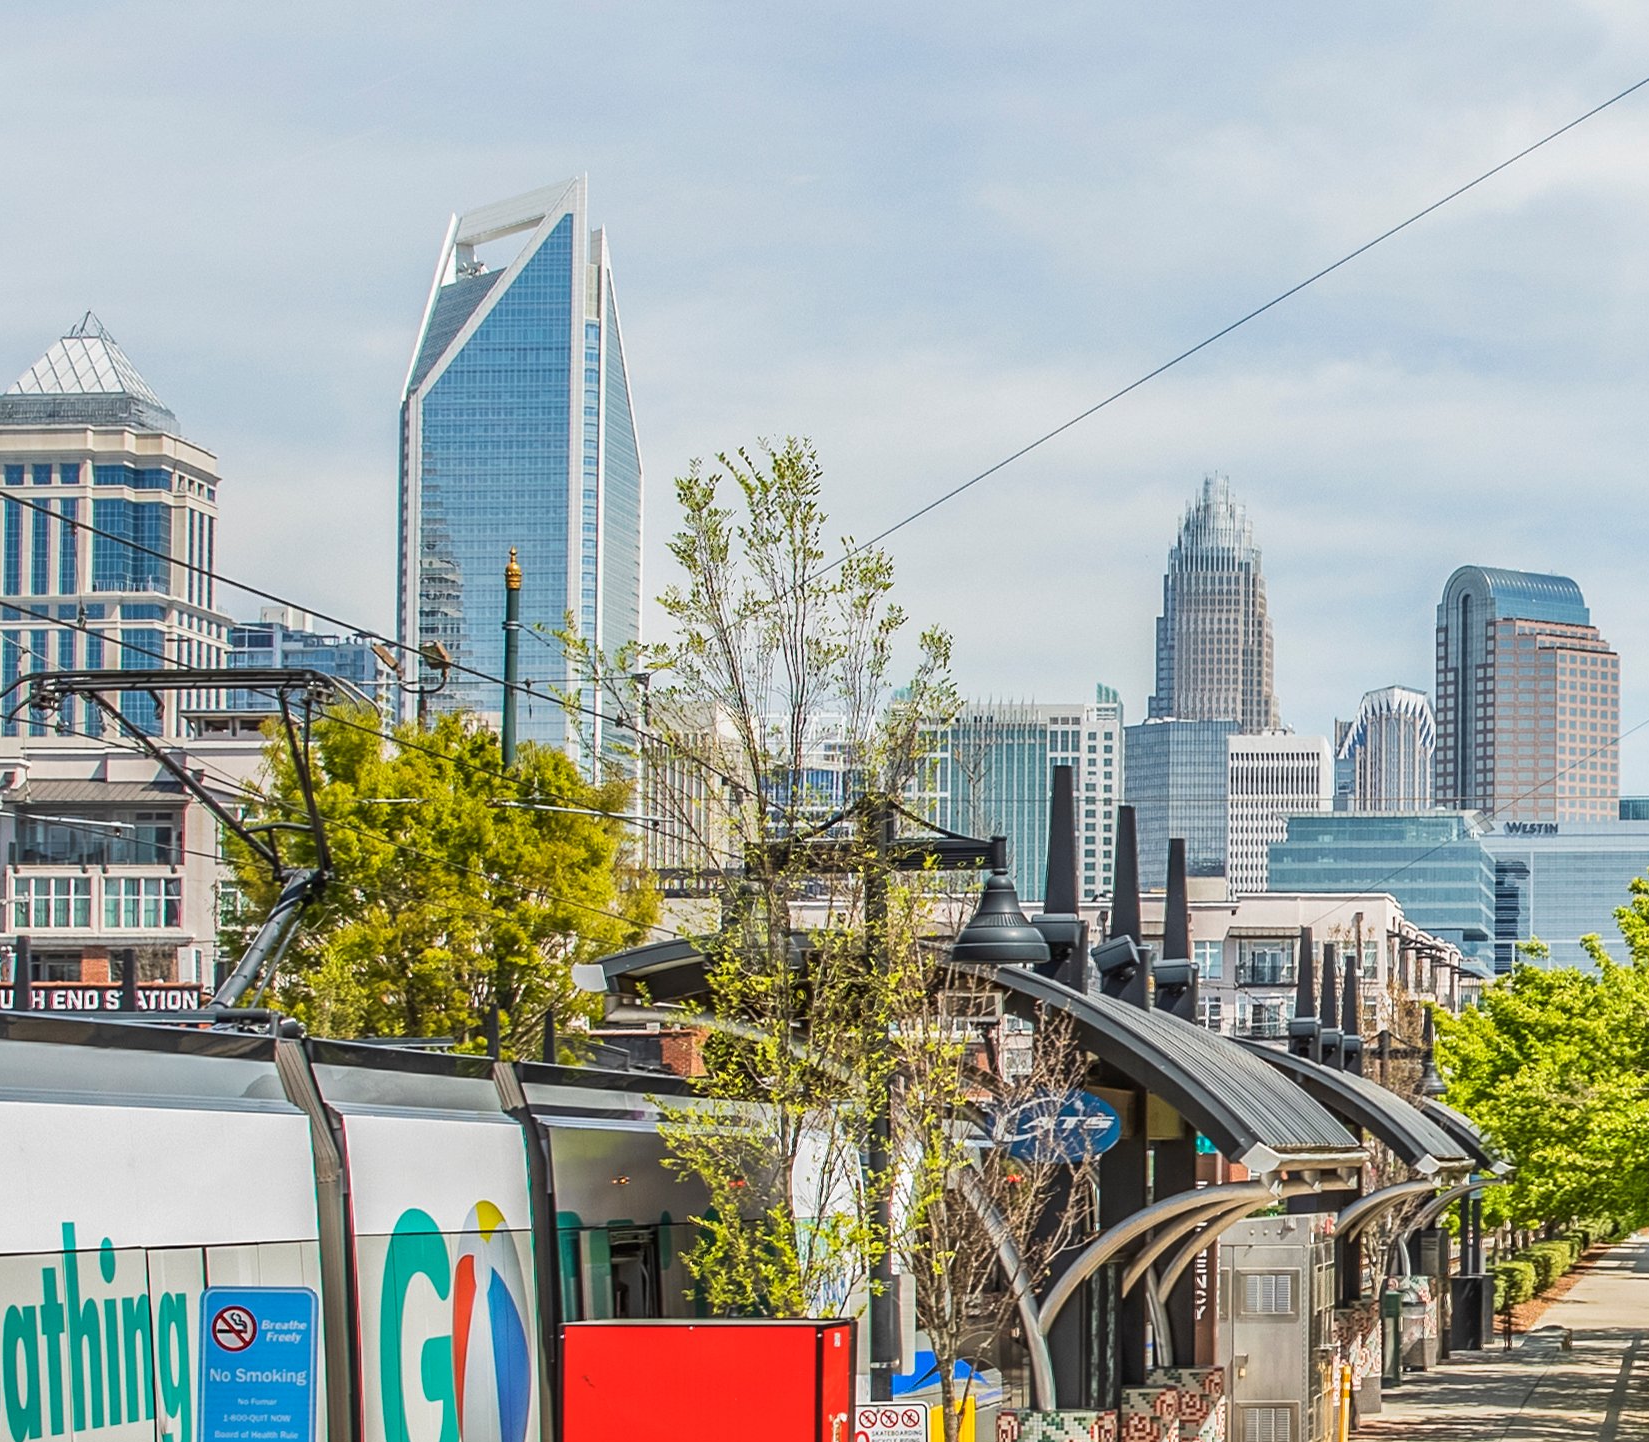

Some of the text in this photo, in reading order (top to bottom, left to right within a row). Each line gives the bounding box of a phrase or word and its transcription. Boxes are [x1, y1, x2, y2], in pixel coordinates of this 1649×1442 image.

[51, 988, 99, 1010] END
[103, 988, 200, 1011] SATION
[261, 1319, 307, 1331] Breathe
[266, 1332, 302, 1344] Freely
[209, 1368, 307, 1386] No Smoking
[270, 1413, 292, 1423] NOW
[252, 1430, 279, 1440] Health
